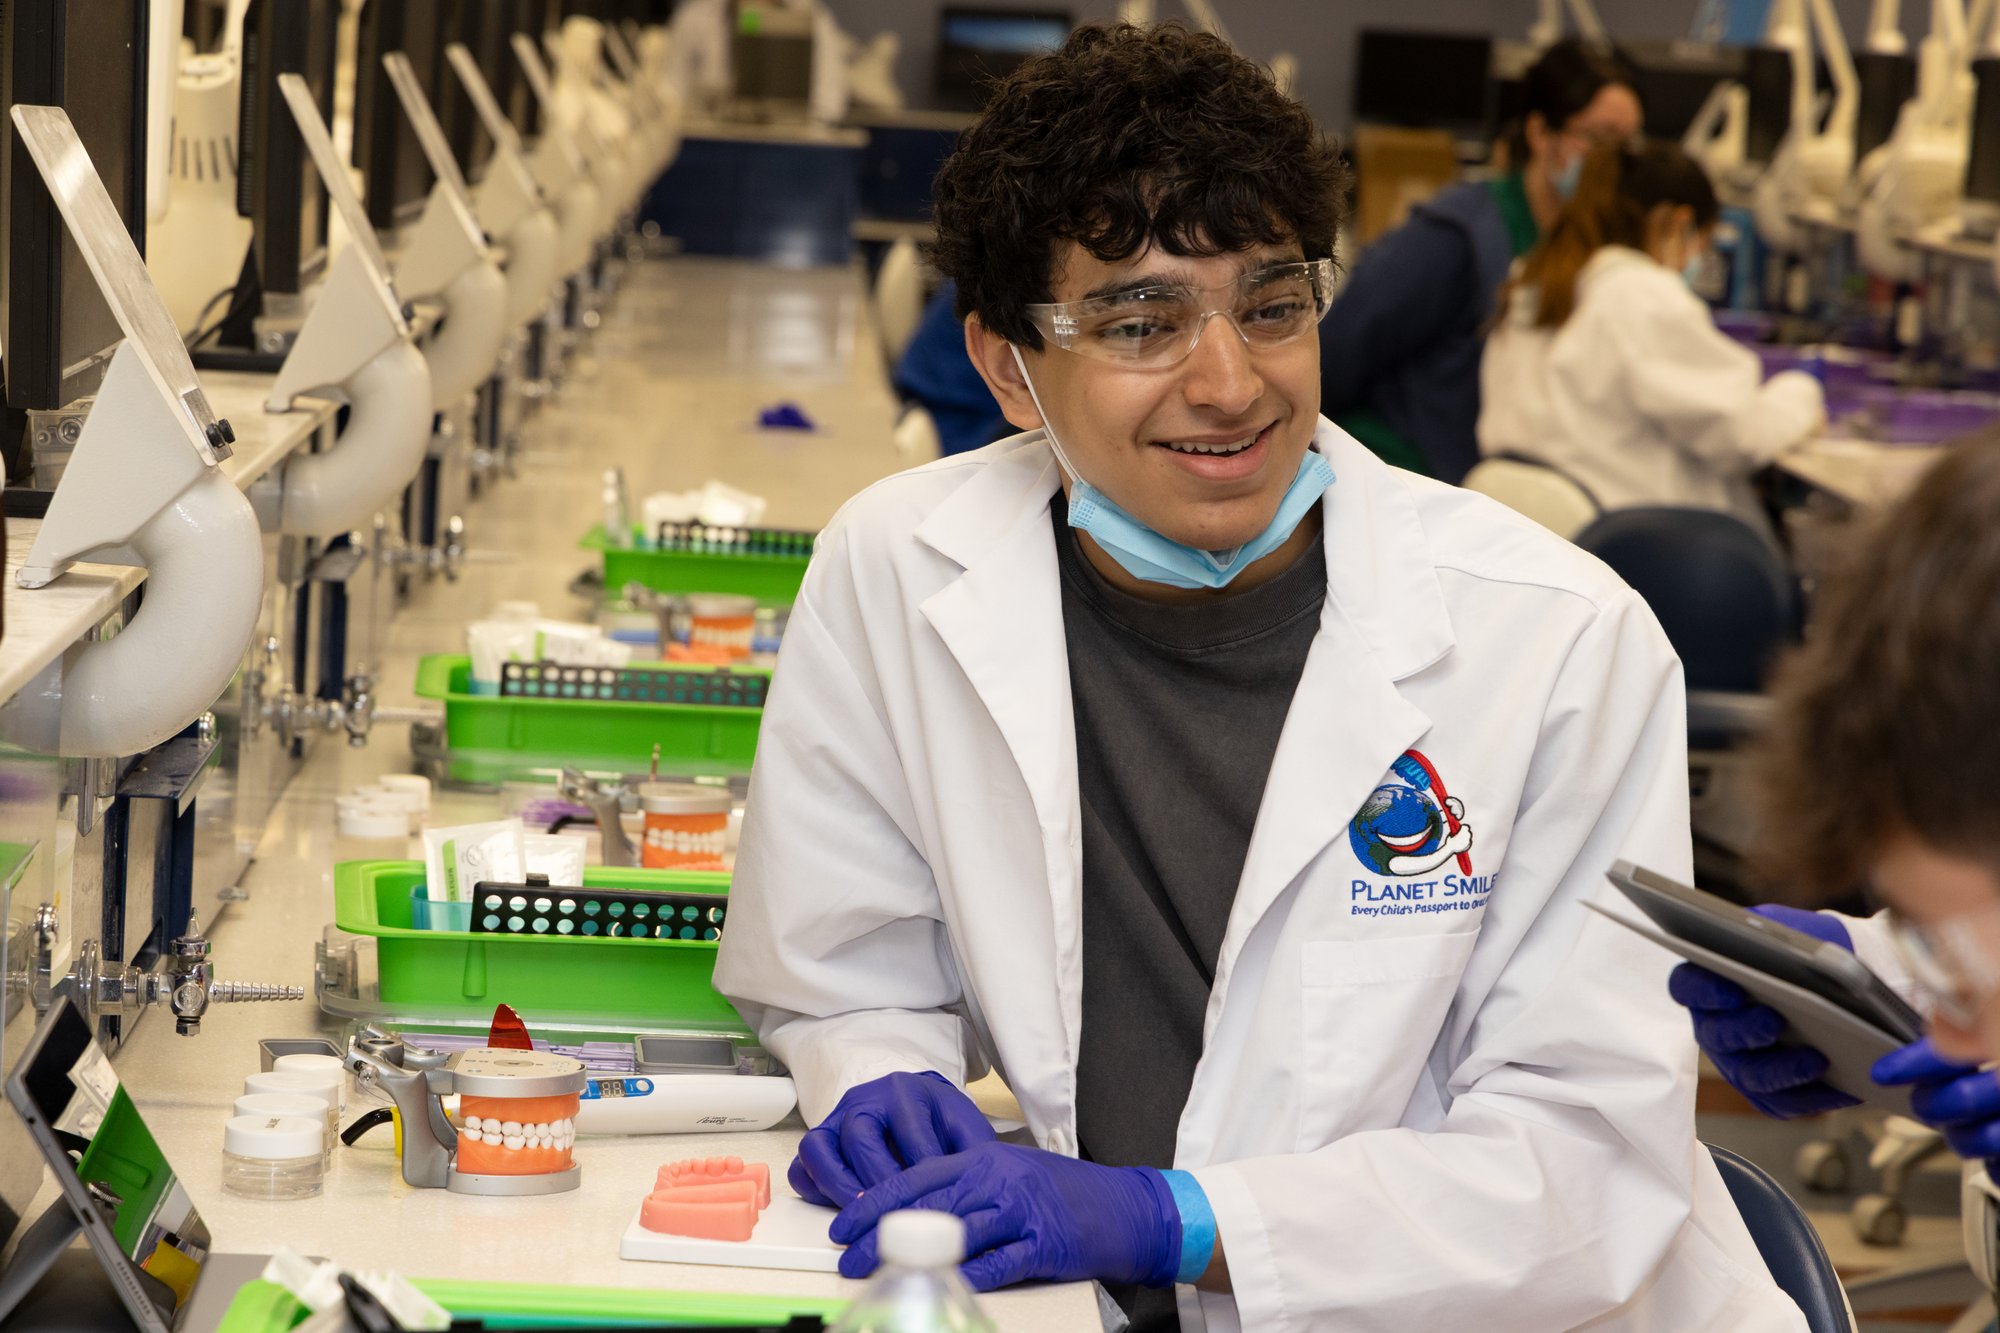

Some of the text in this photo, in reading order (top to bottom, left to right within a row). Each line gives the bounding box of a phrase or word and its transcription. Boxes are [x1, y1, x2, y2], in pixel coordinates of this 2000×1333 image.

[1352, 880, 1438, 901] PLANET
[1351, 905, 1379, 918] Every
[1380, 903, 1413, 916] Child's
[1415, 901, 1457, 915] Passport
[1460, 900, 1470, 911] to
